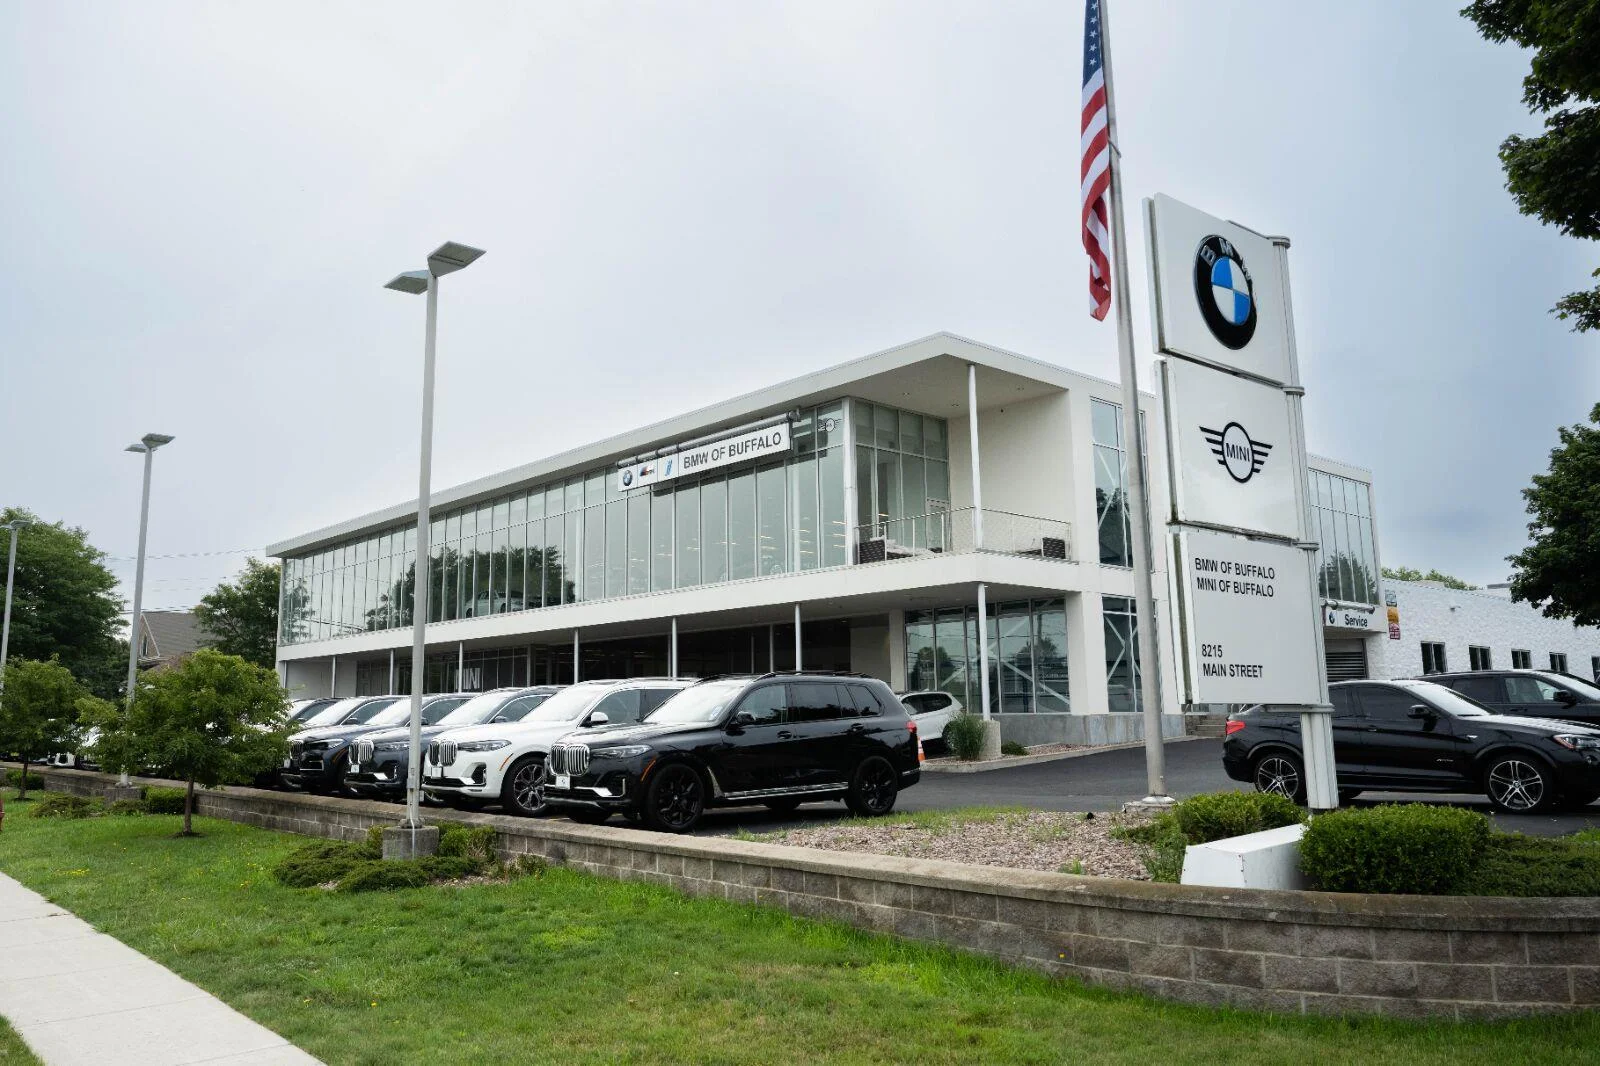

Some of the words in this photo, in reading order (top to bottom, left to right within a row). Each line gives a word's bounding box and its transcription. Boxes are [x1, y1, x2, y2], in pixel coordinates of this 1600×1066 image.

[683, 451, 709, 469] BMW
[711, 447, 726, 461] OF
[728, 432, 781, 457] BUFFALO
[1225, 442, 1250, 461] MINI
[1195, 557, 1218, 573] BMW
[1220, 561, 1232, 575] OF
[1234, 562, 1275, 580] BUFFALO
[1196, 577, 1217, 592] MINI
[1218, 580, 1231, 593] OF
[1233, 581, 1274, 598] BUFFALO
[1344, 613, 1368, 628] Service
[1201, 643, 1223, 658] 8215
[1202, 663, 1227, 677] MAIN
[1228, 663, 1263, 678] STREET
